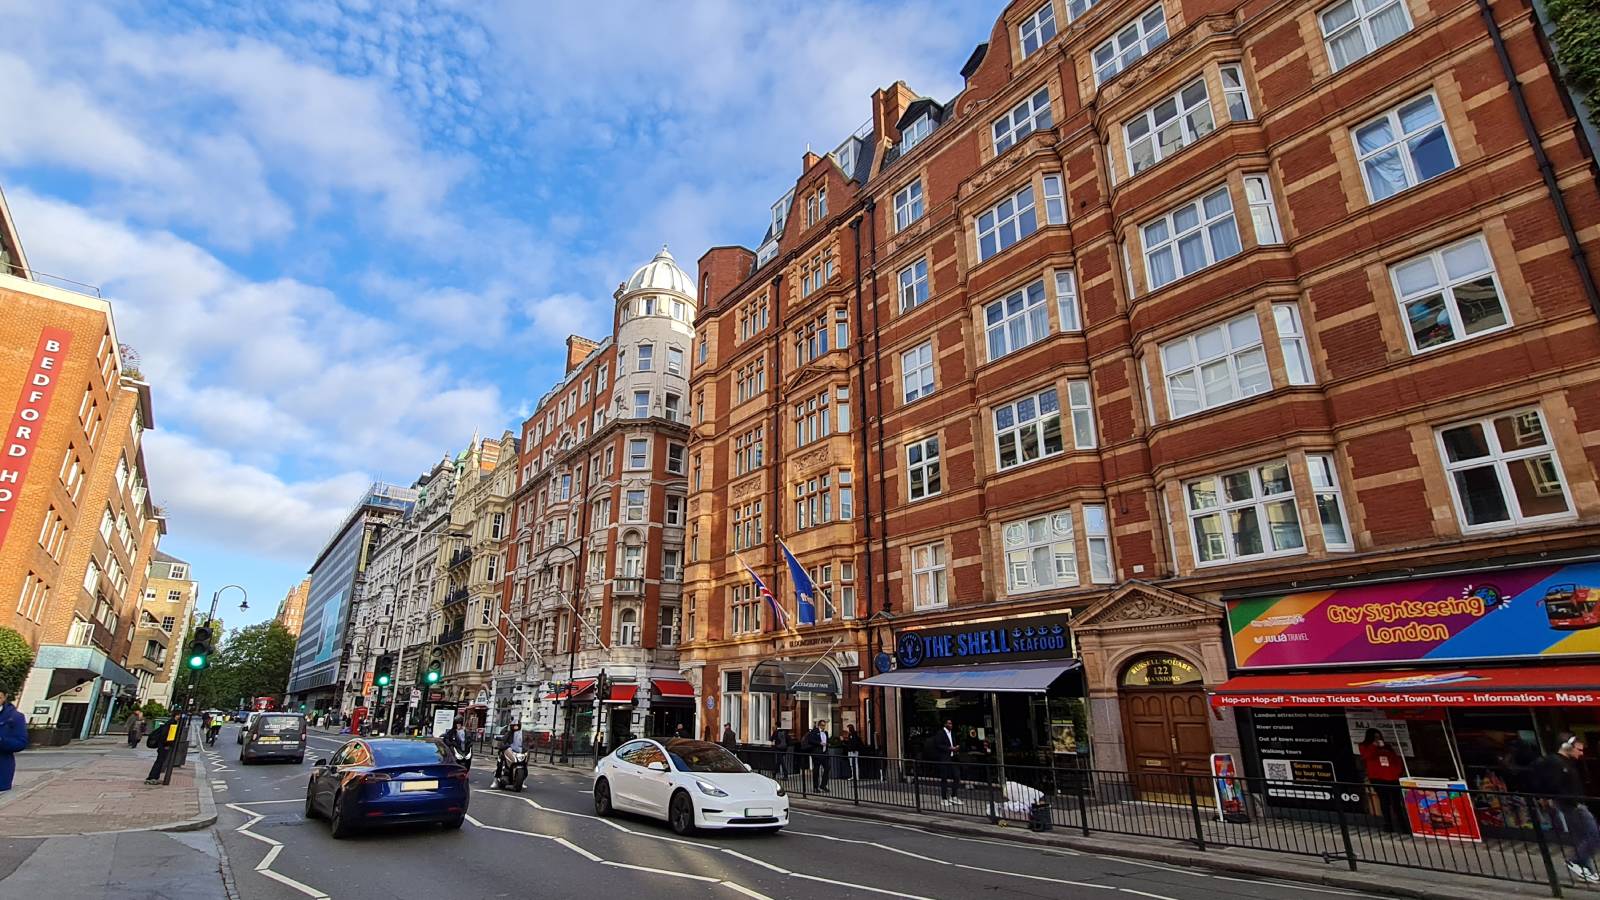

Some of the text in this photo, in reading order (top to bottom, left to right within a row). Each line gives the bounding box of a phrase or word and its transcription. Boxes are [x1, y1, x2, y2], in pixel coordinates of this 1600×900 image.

[0, 340, 60, 513] BEDFORD HO
[1327, 604, 1363, 624] City
[1364, 597, 1485, 622] Sightseeing
[1287, 632, 1310, 642] TRAVEL
[1366, 622, 1449, 642] London
[923, 628, 1065, 658] THE SHELL SEAFOOD
[1131, 658, 1193, 675] RUSSELL SQUARE
[1153, 666, 1169, 675] 122
[1144, 675, 1181, 683] MANSIONS
[1221, 696, 1251, 704] Hop-on
[1252, 696, 1284, 704] Hop-off
[1290, 695, 1326, 703] Theatre
[1326, 695, 1361, 703] Tickets
[1367, 694, 1432, 703] Out-of-Town
[1432, 694, 1465, 703] Tours
[1473, 693, 1546, 703] Information
[1555, 693, 1594, 703] Maps
